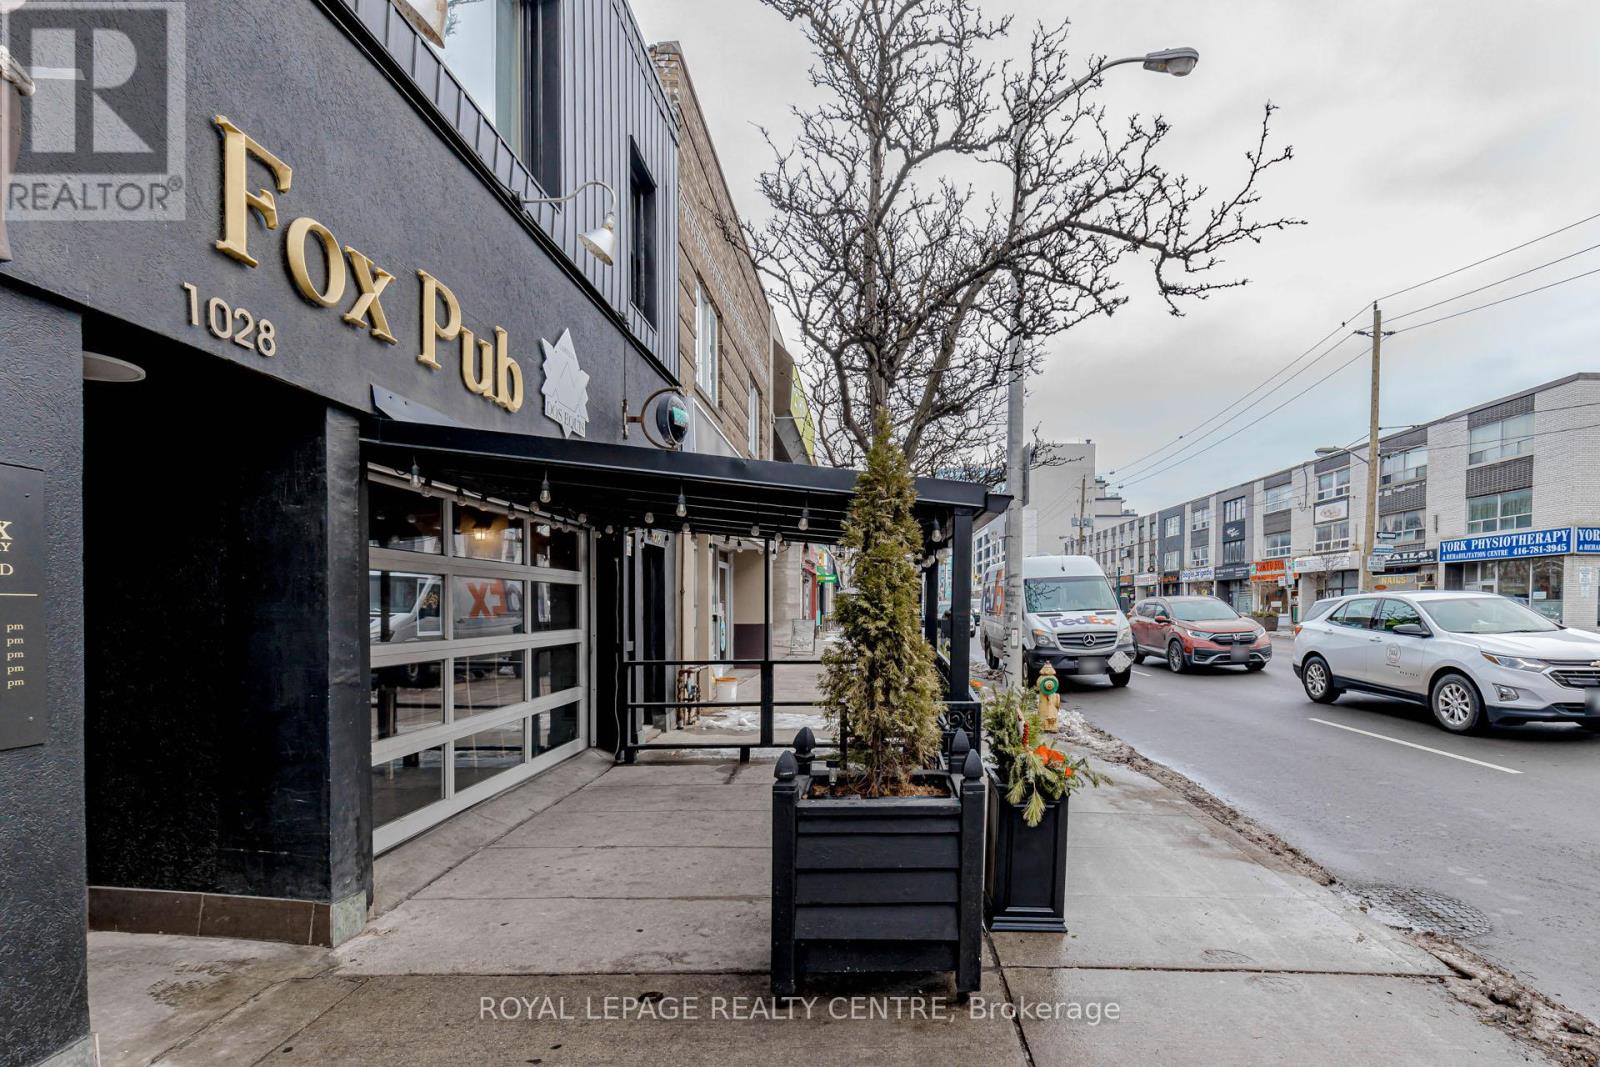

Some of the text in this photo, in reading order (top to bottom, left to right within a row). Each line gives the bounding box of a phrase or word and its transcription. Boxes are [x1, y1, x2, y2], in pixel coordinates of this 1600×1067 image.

[214, 114, 525, 413] Fox Pub
[183, 282, 277, 358] 1028
[1441, 529, 1570, 552] YORK PHYSIOTHERAPY
[1487, 549, 1509, 557] CENTRE
[1049, 615, 1117, 628] FedEx
[7, 623, 24, 633] pm
[7, 637, 24, 647] pm
[7, 651, 24, 661] pm
[7, 665, 24, 675] pm
[7, 679, 24, 689] pm
